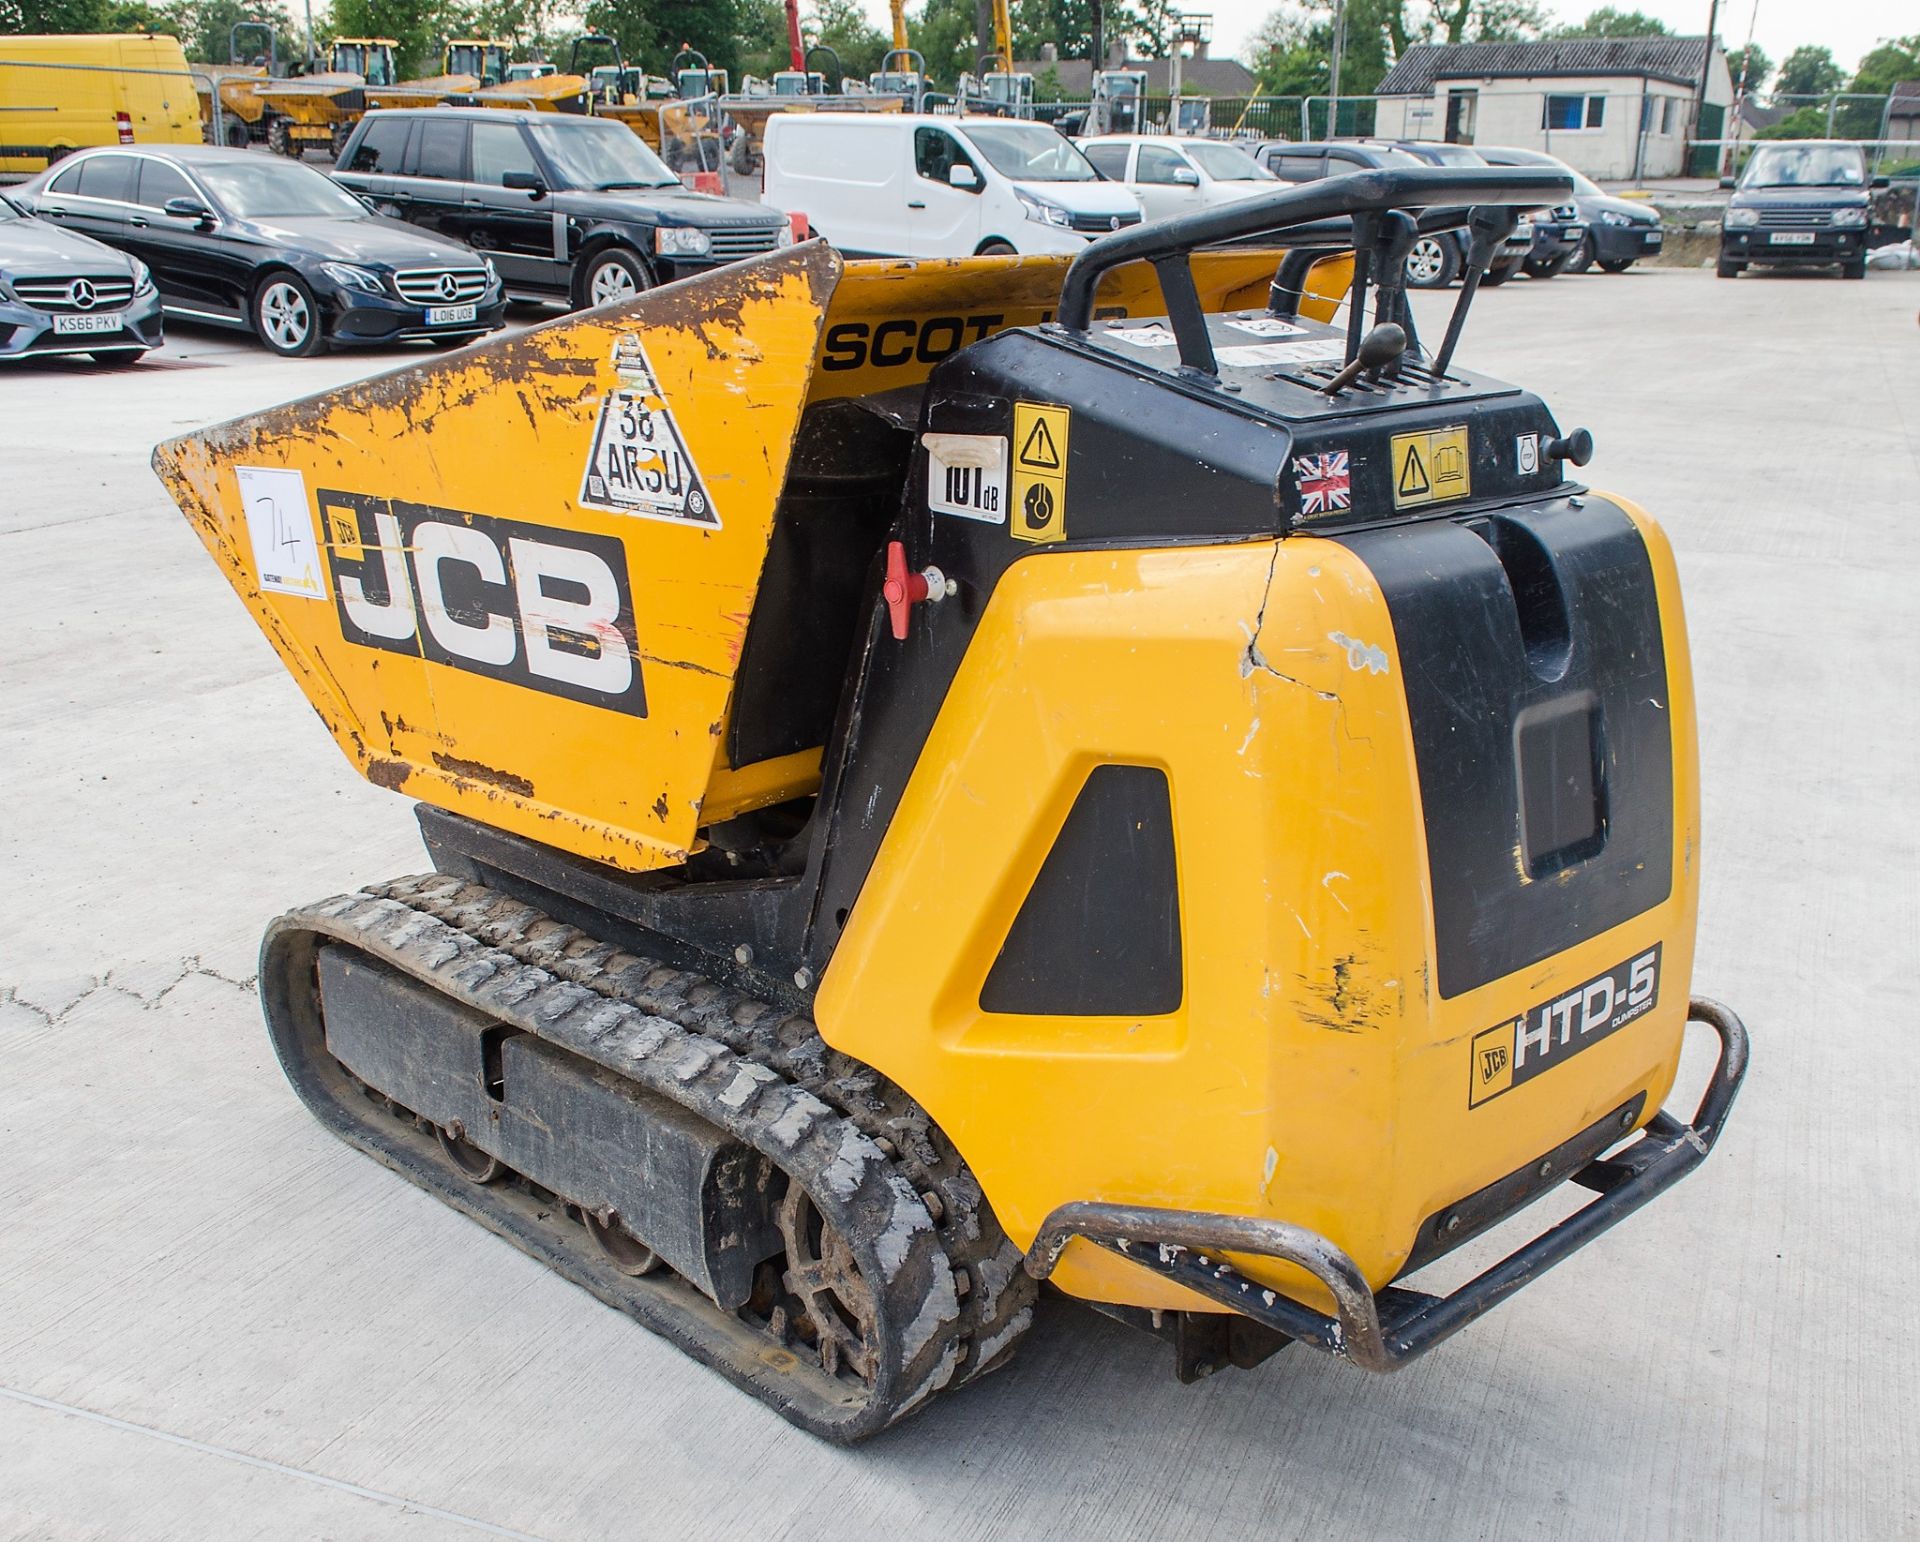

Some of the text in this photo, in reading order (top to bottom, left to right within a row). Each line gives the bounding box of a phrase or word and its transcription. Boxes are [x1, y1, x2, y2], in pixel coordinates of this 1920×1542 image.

[59, 315, 118, 331] KS66 PKV
[434, 309, 455, 322] LO16
[822, 313, 1004, 372] SCOT
[983, 485, 999, 512] dB
[256, 497, 301, 564] 74
[335, 519, 357, 545] JCB
[338, 512, 633, 695] JCB
[1514, 950, 1656, 1069] HTD-5
[1611, 997, 1653, 1028] DUMPSTER
[1483, 1048, 1508, 1080] JCB
